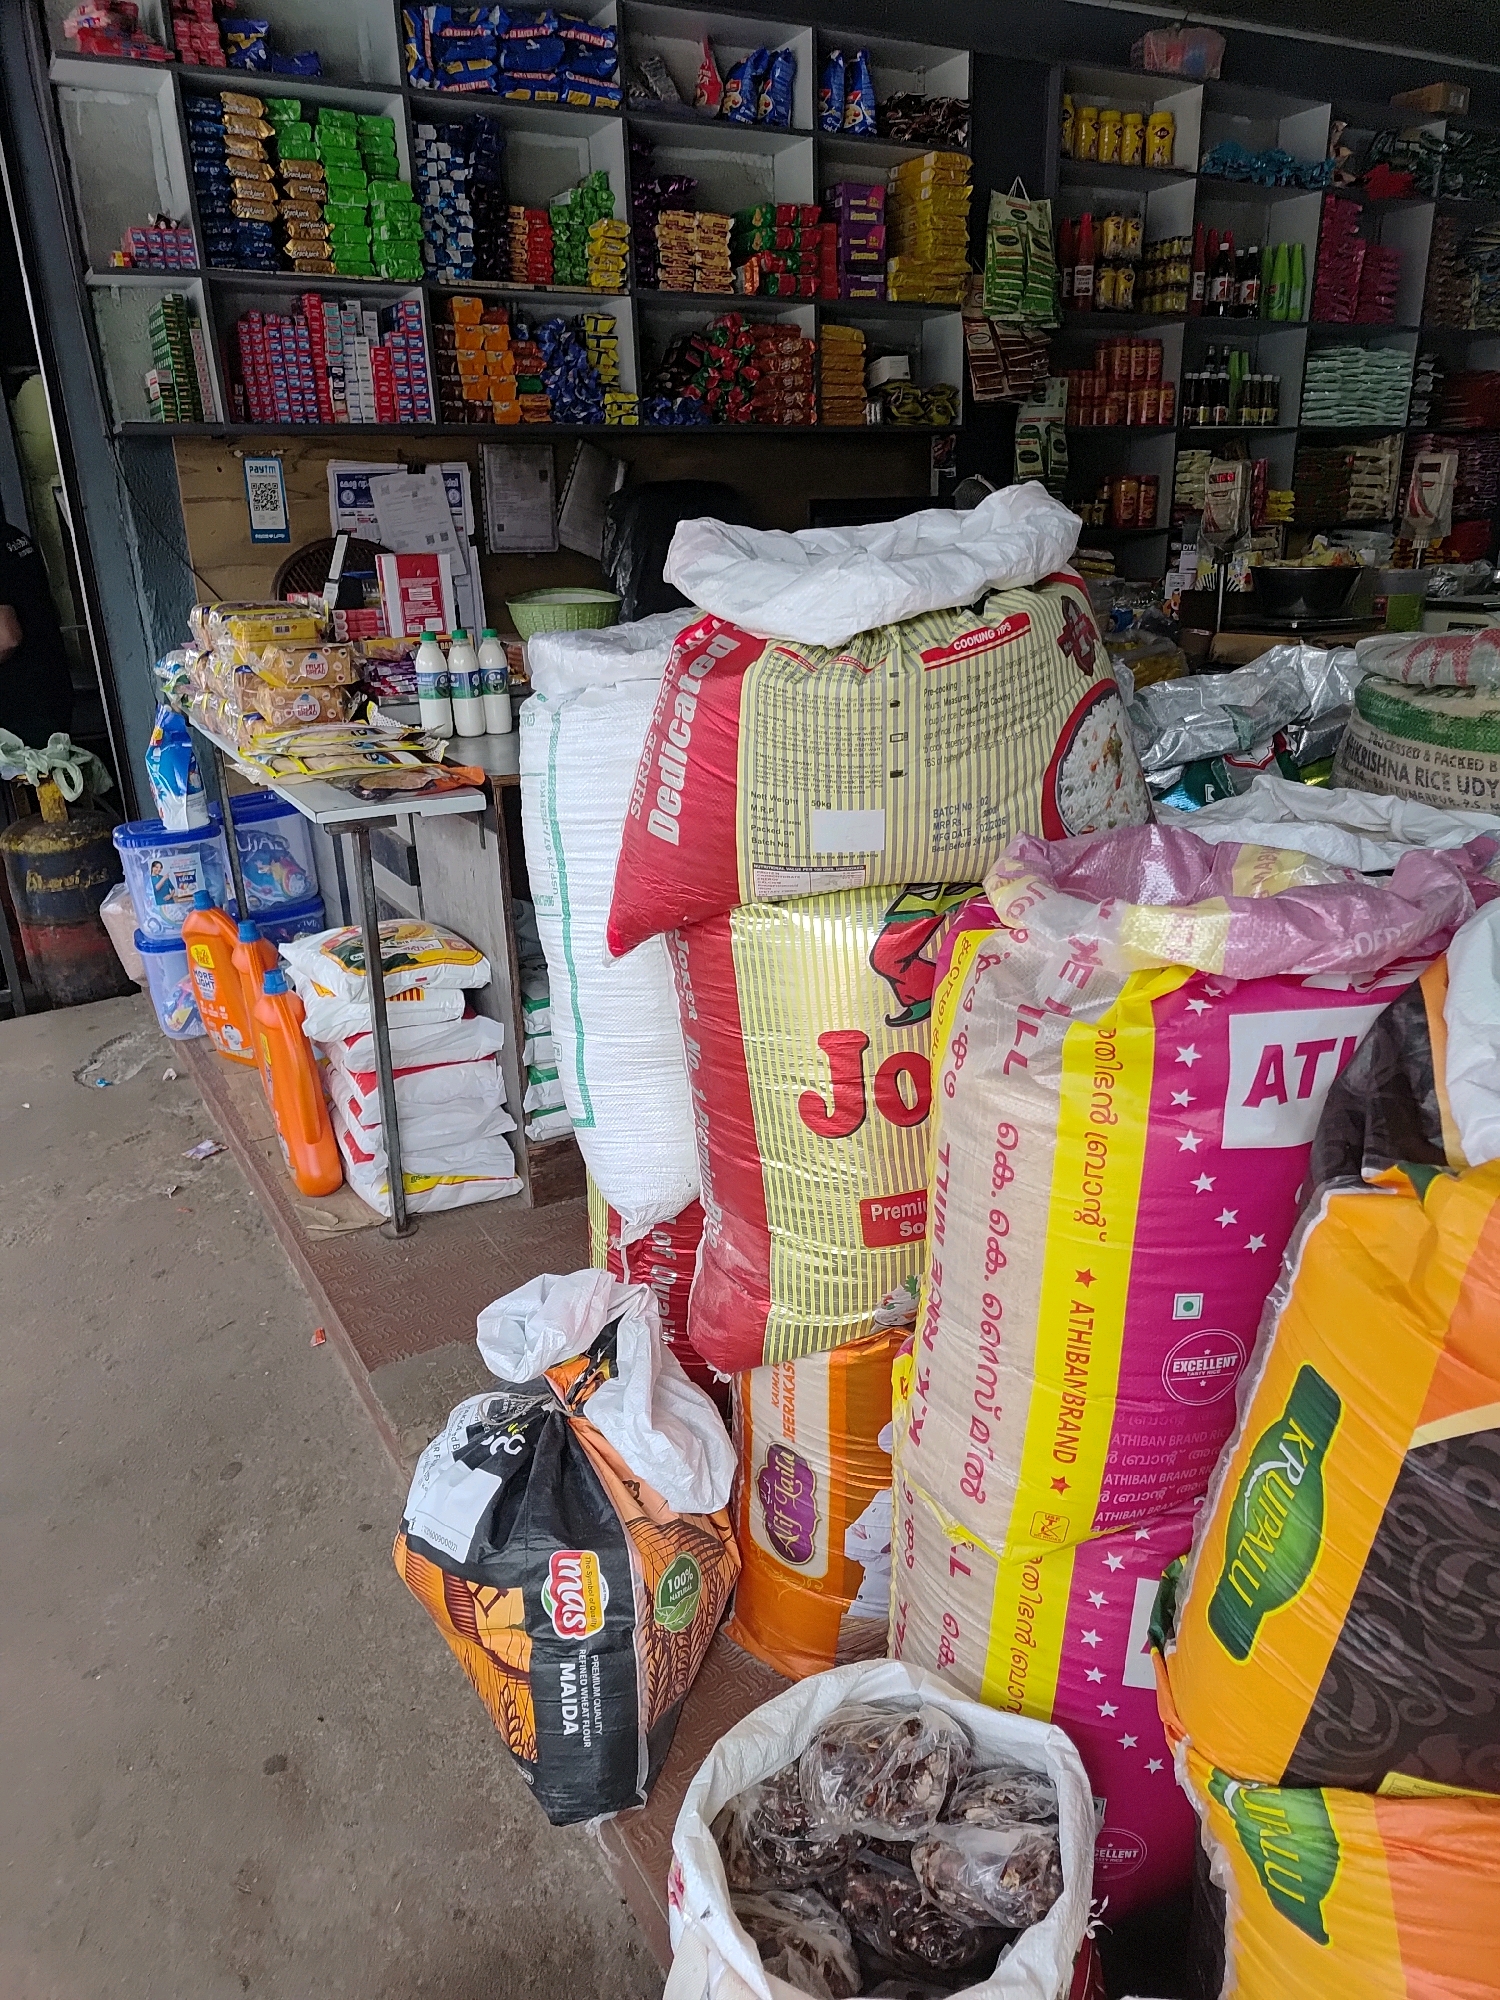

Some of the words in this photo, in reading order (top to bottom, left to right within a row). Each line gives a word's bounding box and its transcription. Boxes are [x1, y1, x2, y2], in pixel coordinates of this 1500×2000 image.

[953, 628, 996, 650] COOKING
[996, 622, 1012, 636] TIPS
[924, 682, 958, 698] Pre-cooking
[944, 694, 970, 707] Measures
[960, 704, 978, 717] Closed
[980, 700, 990, 710] Pan
[990, 693, 1011, 706] Cooking
[648, 634, 741, 846] Dedicated
[1434, 752, 1484, 772] PACKED
[631, 731, 658, 821] SHREE
[1416, 766, 1450, 792] RICE
[1456, 775, 1500, 798] UDY
[750, 791, 768, 800] Nett
[770, 794, 798, 806] Weight
[811, 800, 832, 809] 50kg
[933, 803, 960, 818] BATCH
[980, 796, 988, 806] 02
[750, 824, 780, 835] Packed
[932, 832, 950, 843] MFG
[952, 827, 972, 840] DATE
[933, 820, 951, 831] MRP
[751, 837, 776, 846] Batch
[778, 840, 792, 848] No.
[932, 844, 948, 853] Best
[950, 842, 972, 851] Before
[982, 832, 1006, 844] Months
[193, 968, 214, 980] MORE
[675, 929, 699, 1022] JOKER
[797, 1030, 930, 1139] Jo
[898, 1220, 925, 1238] So
[922, 1253, 944, 1352] RICE
[934, 1142, 951, 1247] MILL
[1172, 1356, 1238, 1374] EXCELLENT
[770, 1370, 782, 1408] KAIMA
[1052, 1300, 1097, 1467] ATHIBANBRAND
[1112, 1433, 1167, 1448] ATHIBAN
[1168, 1432, 1208, 1447] BRAND
[774, 1450, 803, 1511] Laila
[1104, 1472, 1157, 1487] ATHIBAN
[1159, 1468, 1196, 1485] BRAND
[1096, 1508, 1146, 1522] ATHIBAN
[1227, 1417, 1316, 1608] KRUPALU
[770, 1502, 803, 1559] Alif
[584, 1556, 592, 1570] The
[586, 1570, 594, 1597] Symbol
[666, 1566, 694, 1594] 100%
[669, 1582, 694, 1603] NATURAL
[558, 1558, 587, 1634] mas
[588, 1596, 595, 1604] of
[590, 1604, 598, 1629] Quality
[578, 1648, 588, 1687] REFINED
[590, 1654, 601, 1694] PREMIUM
[560, 1662, 580, 1737] MAIDA
[581, 1686, 590, 1719] WHEAT
[592, 1694, 603, 1736] QUALITY
[583, 1718, 592, 1749] FLOUR
[1094, 1850, 1139, 1859] CELLENT
